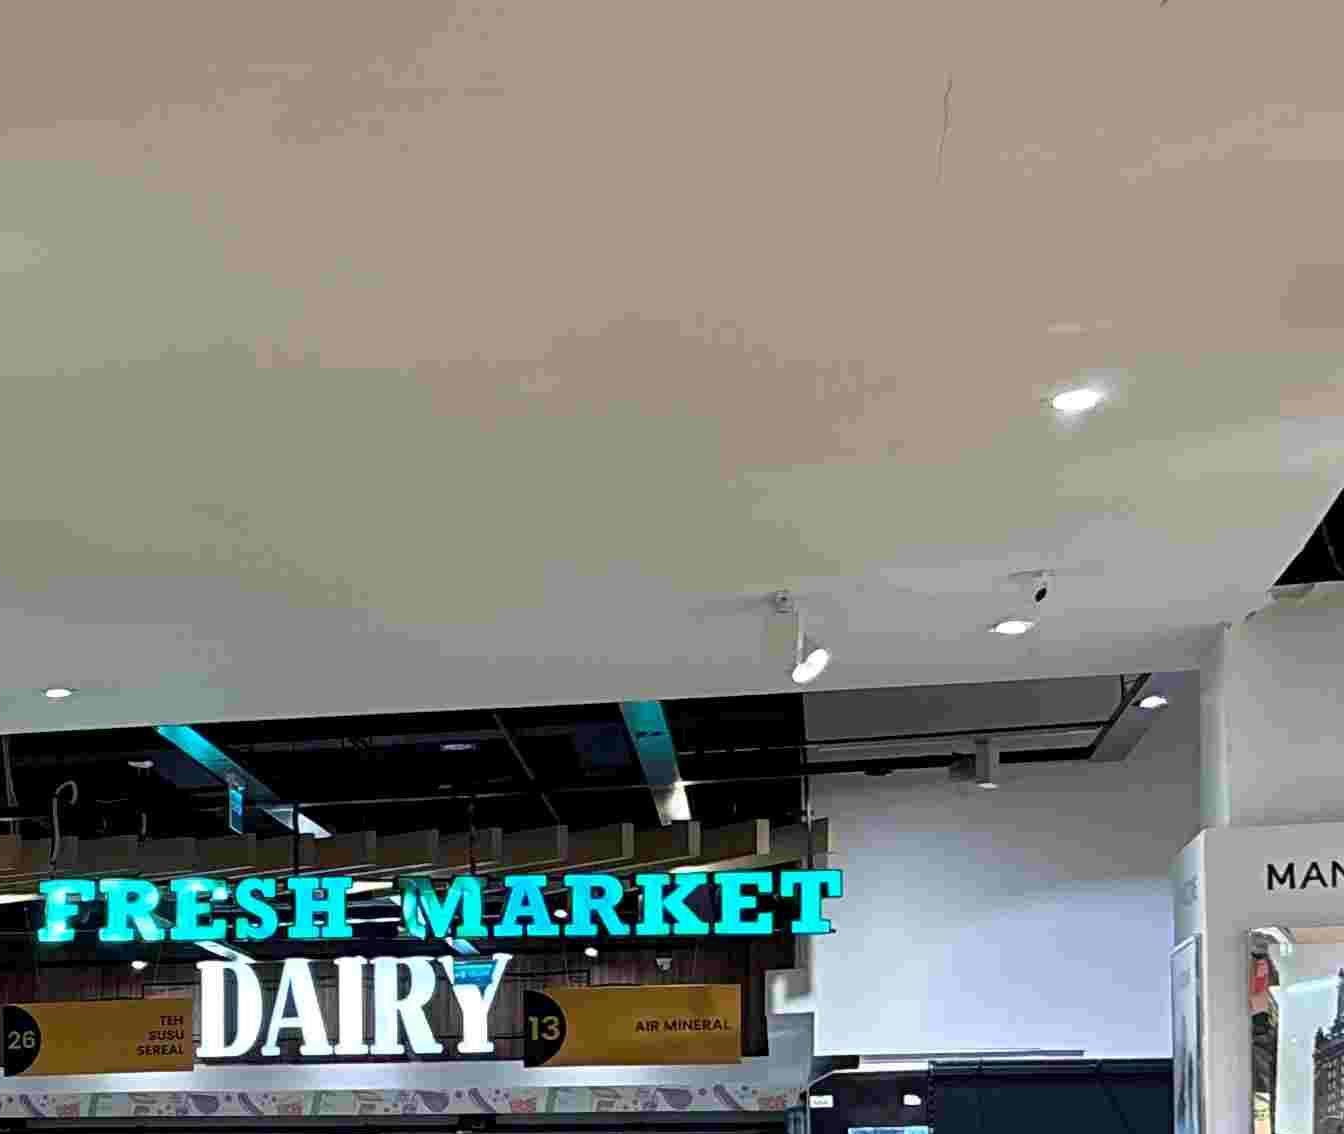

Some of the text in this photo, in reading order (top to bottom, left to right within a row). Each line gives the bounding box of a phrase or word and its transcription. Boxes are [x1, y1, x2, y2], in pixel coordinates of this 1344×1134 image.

[37, 868, 843, 943] FRESH MARKET
[196, 952, 512, 1058] DAIRY
[160, 1015, 184, 1026] TEH
[527, 1015, 561, 1041] 13
[635, 1017, 733, 1033] AIR MINERAL
[7, 1030, 36, 1049] 26
[148, 1030, 185, 1041] SUSU
[135, 1044, 185, 1057] SEREAL
